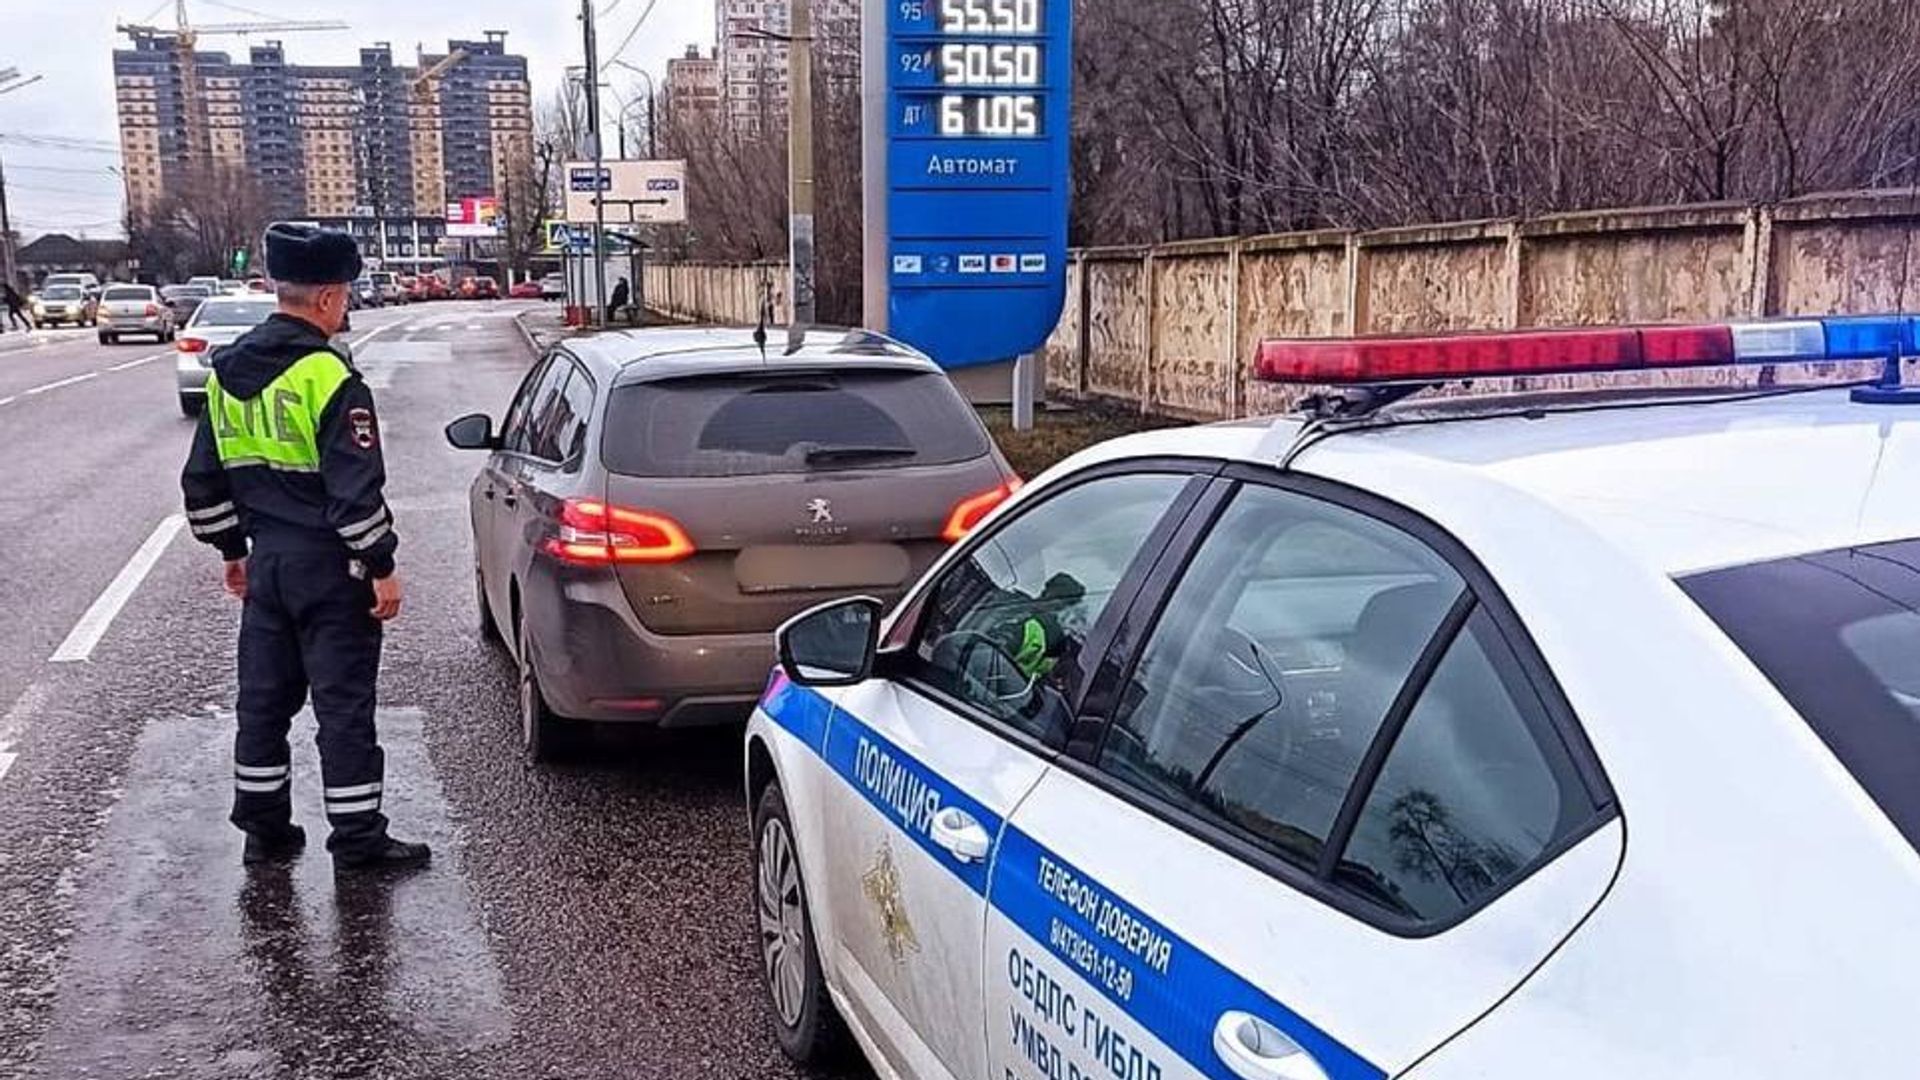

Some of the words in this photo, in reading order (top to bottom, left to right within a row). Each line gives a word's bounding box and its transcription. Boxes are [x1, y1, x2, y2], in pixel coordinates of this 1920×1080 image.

[901, 3, 922, 21] 95
[942, 0, 1037, 32] 55.50
[901, 54, 922, 73] 92
[942, 44, 1037, 84] 50.50
[904, 106, 922, 125] ДТ
[927, 155, 1017, 174] Автомат
[962, 258, 983, 268] VISA
[855, 736, 941, 835] ПОЛИЦИЯ
[1038, 856, 1100, 925] ТЕЛЕФОН
[1096, 900, 1172, 975] ДОВЕРИЯ
[1009, 948, 1077, 1036] ОБДПС
